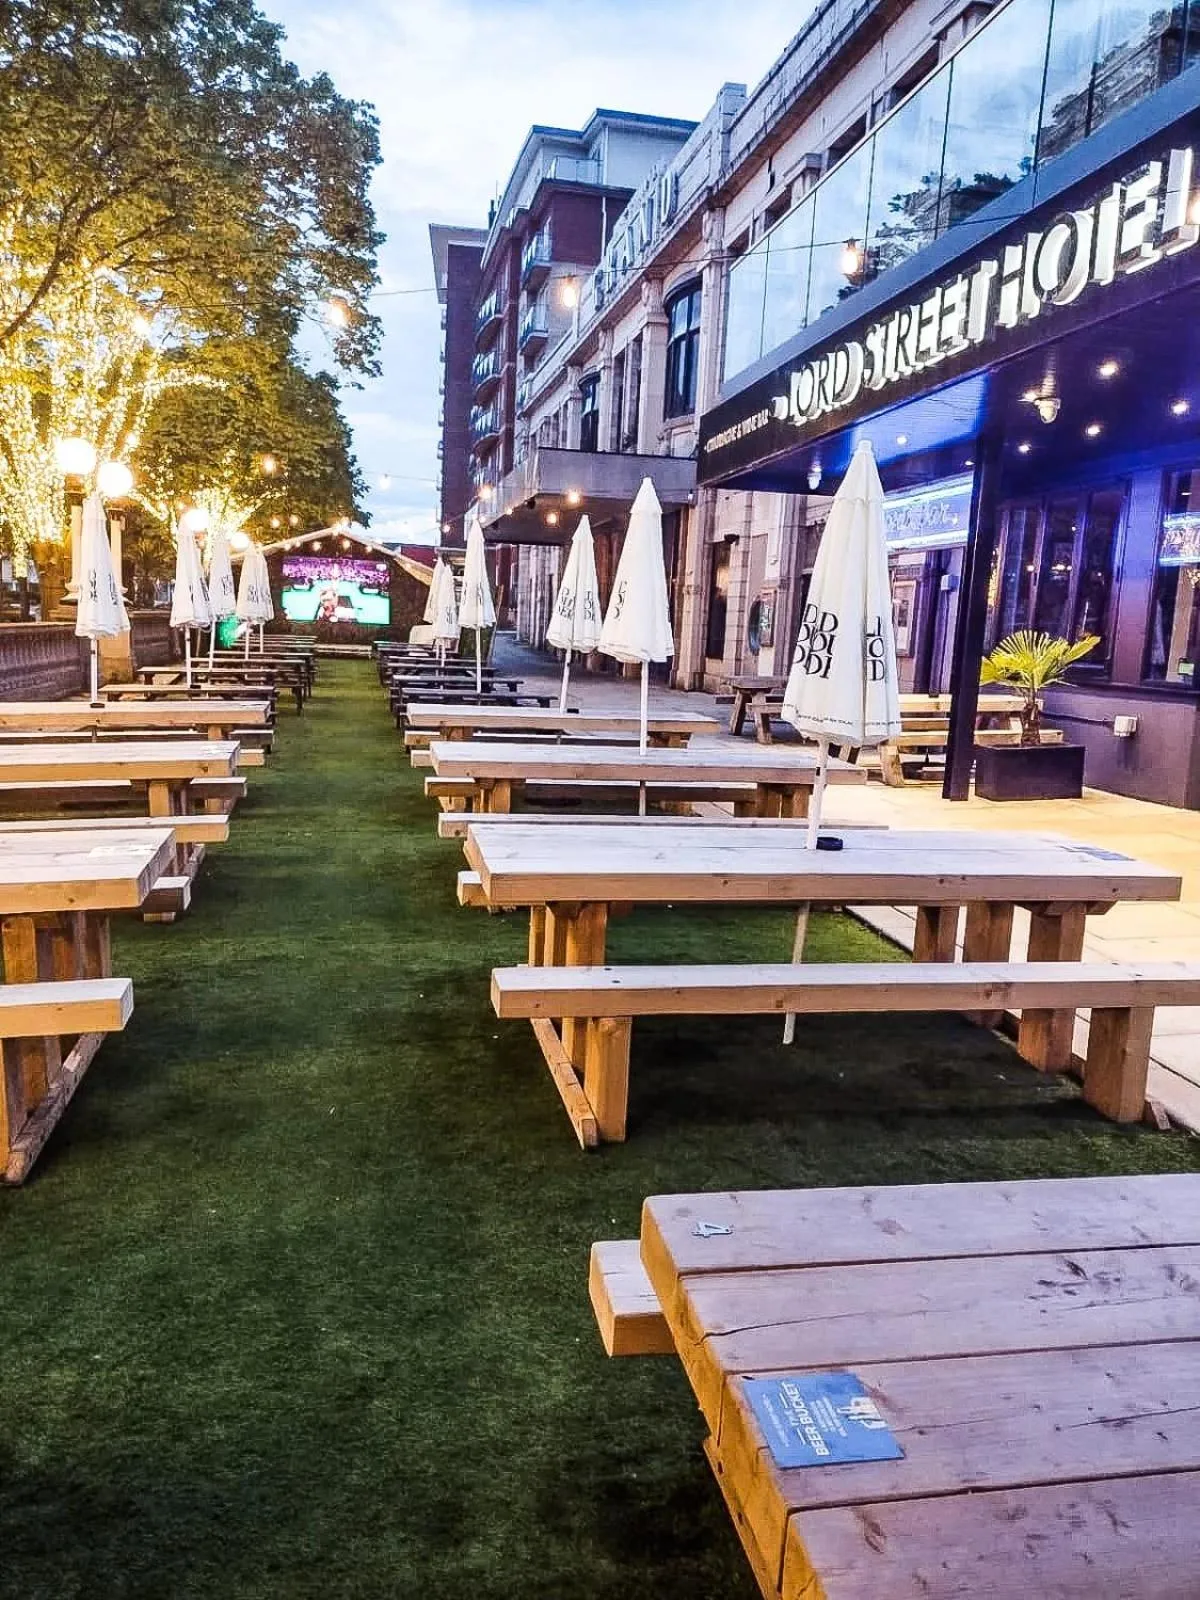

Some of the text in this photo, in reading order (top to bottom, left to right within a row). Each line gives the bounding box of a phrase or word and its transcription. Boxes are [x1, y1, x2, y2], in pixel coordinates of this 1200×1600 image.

[789, 146, 1200, 426] LORD STREET HOTEL
[782, 1382, 815, 1425] BUCKET
[804, 1426, 830, 1456] BEER
